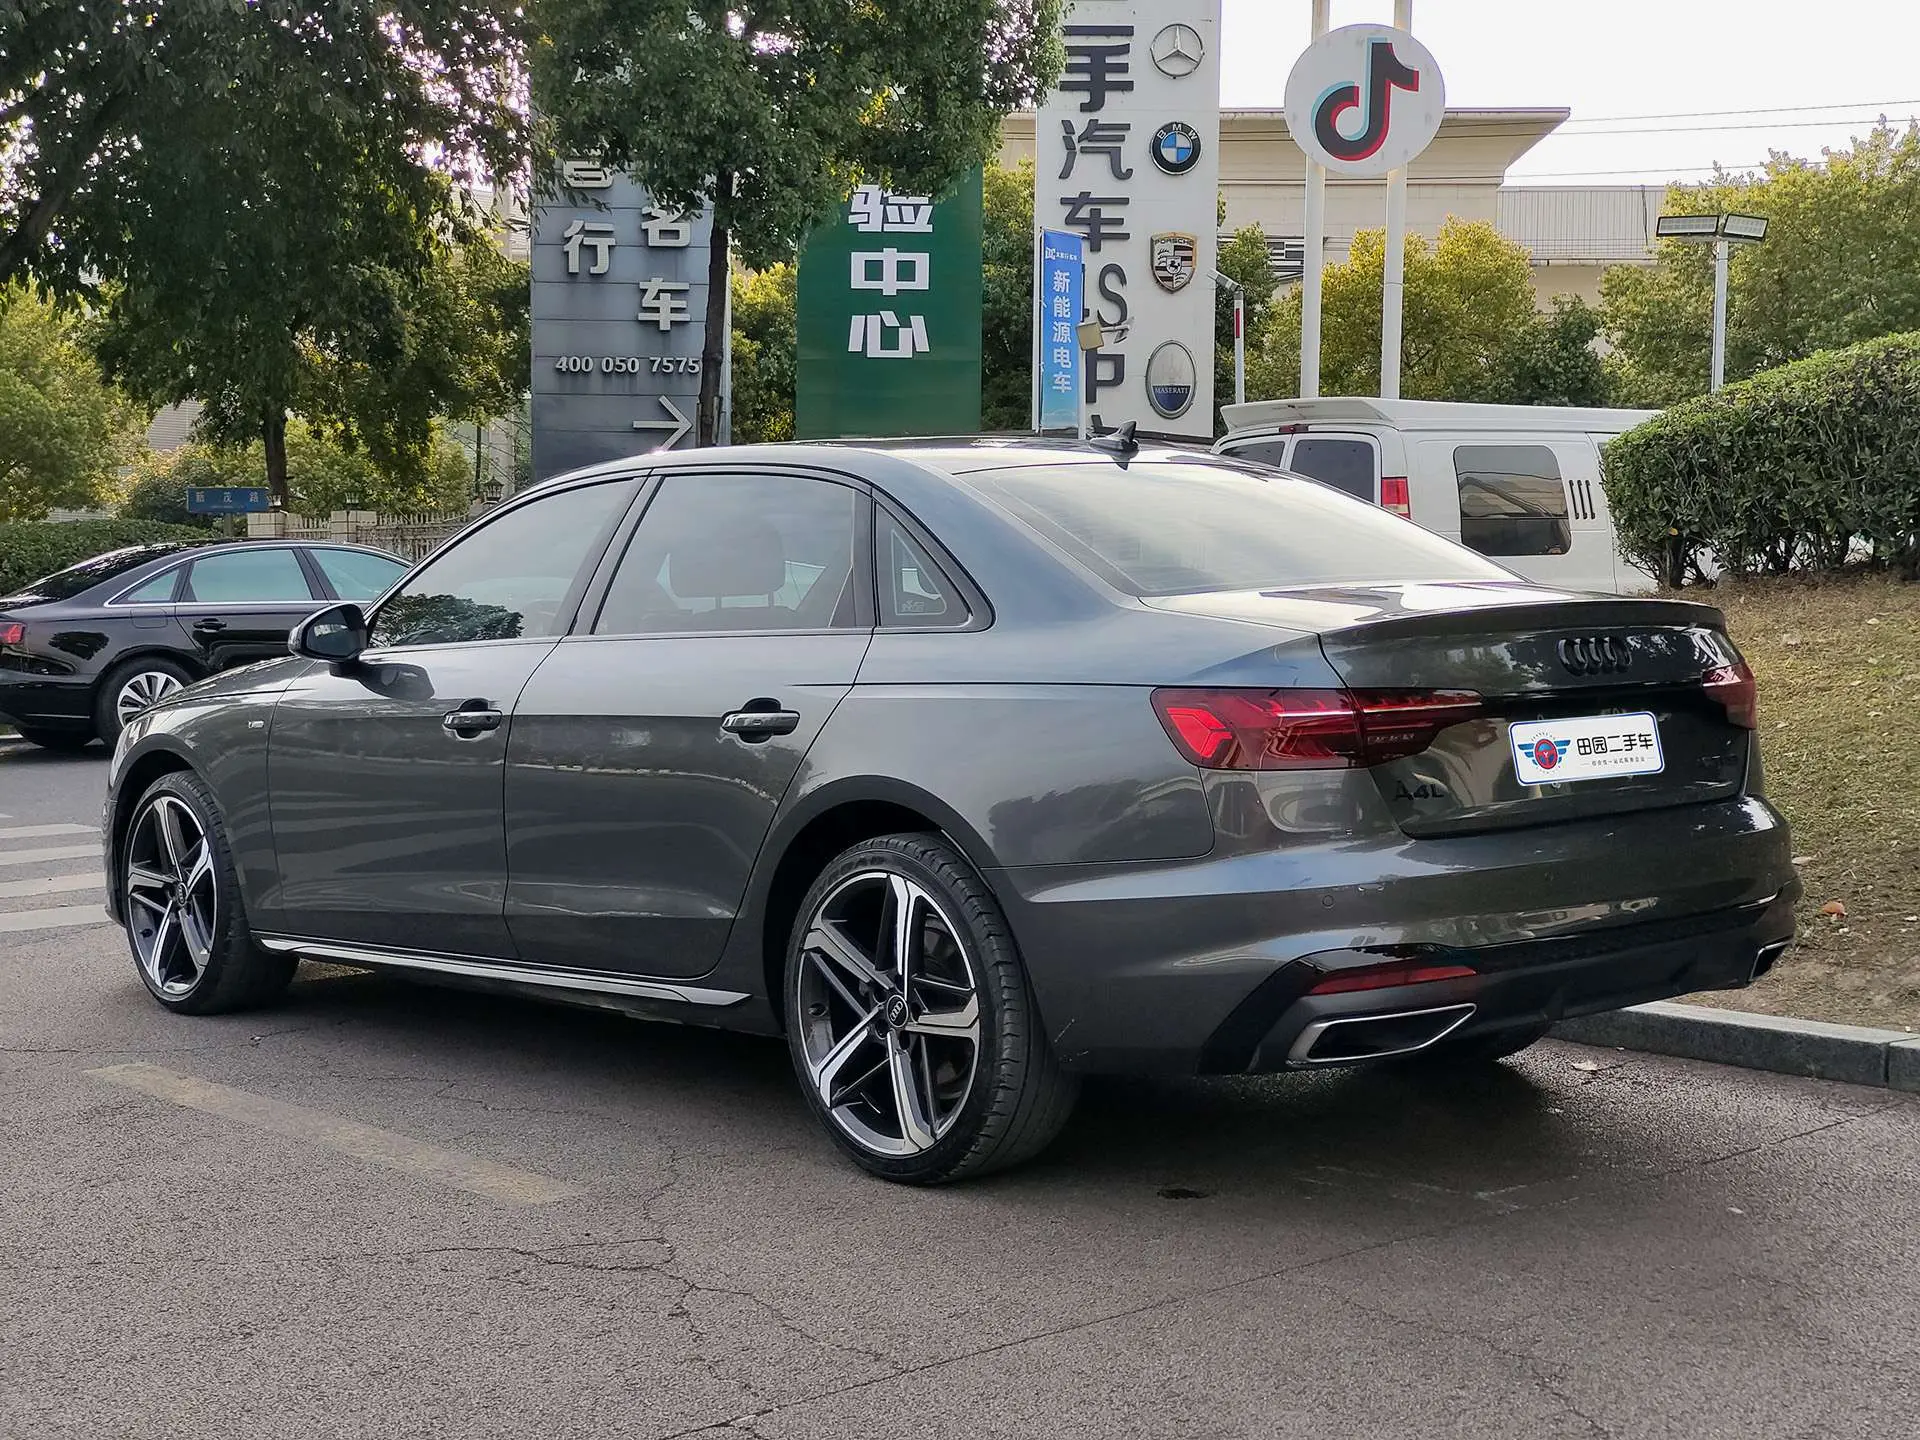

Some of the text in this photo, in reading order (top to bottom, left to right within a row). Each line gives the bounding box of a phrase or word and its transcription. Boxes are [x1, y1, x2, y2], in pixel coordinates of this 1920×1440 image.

[1156, 123, 1198, 140] BMW
[848, 185, 933, 358] 验中心
[1052, 269, 1072, 393] 新能源电车
[555, 356, 700, 374] 400 050 7575
[1576, 732, 1654, 756] 田园二手车
[1395, 779, 1444, 800] A4L
